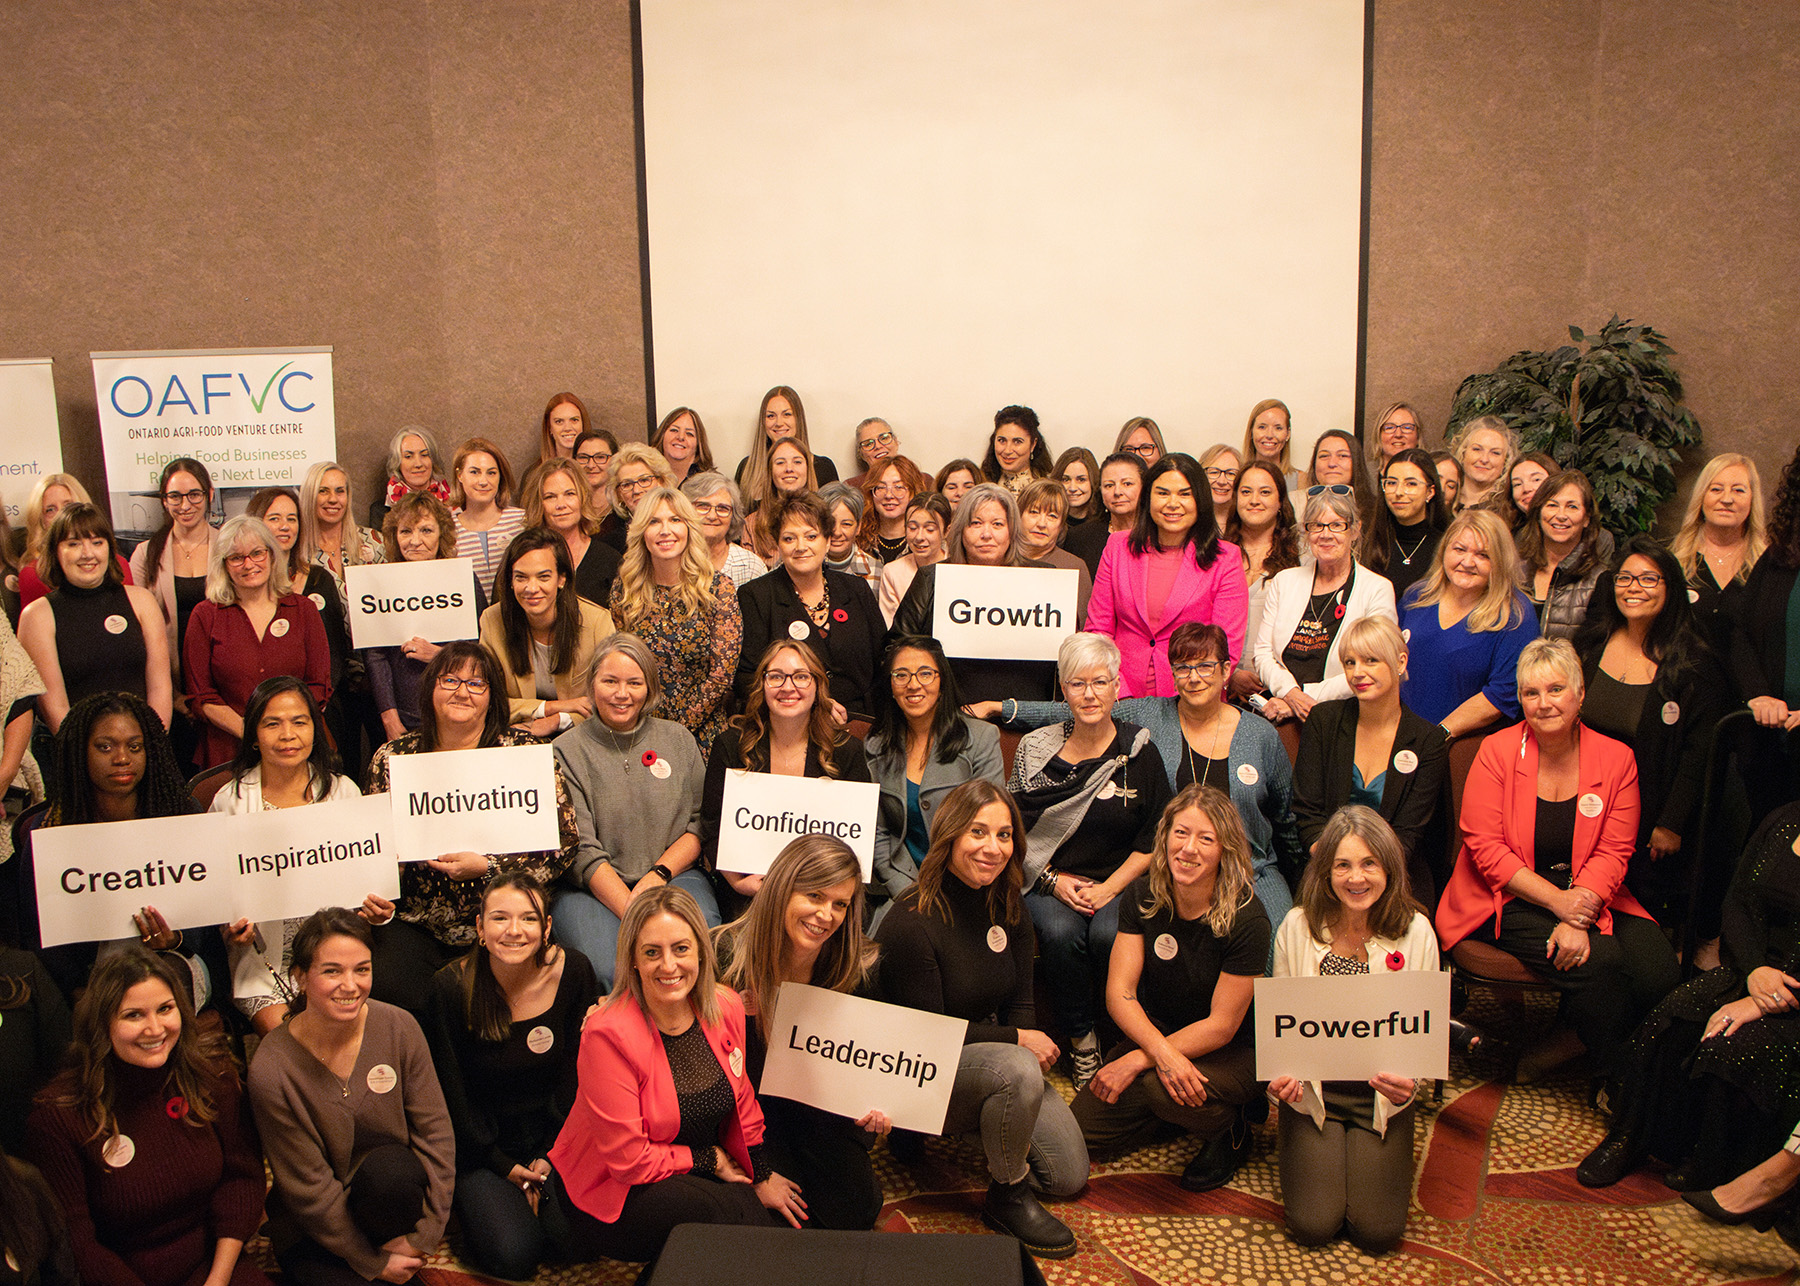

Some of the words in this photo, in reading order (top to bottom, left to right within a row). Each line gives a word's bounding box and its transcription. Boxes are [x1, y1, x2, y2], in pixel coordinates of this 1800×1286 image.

[110, 361, 316, 418] OAFVC
[128, 427, 170, 440] ONTARIO
[173, 425, 223, 438] AGRI-FOOD
[226, 424, 266, 436] VENTURE
[270, 422, 303, 435] CENTRE
[195, 449, 230, 463] Food
[234, 448, 307, 462] Businesses
[222, 468, 254, 481] Next
[258, 466, 293, 480] Level
[361, 592, 464, 615] Success
[948, 599, 1062, 628] Growth
[409, 785, 539, 816] Motivating
[735, 807, 862, 839] Confidence
[238, 832, 382, 877] Inspirational
[60, 859, 208, 895] Creative
[1274, 1009, 1432, 1039] Powerful
[788, 1024, 938, 1088] Leadership
